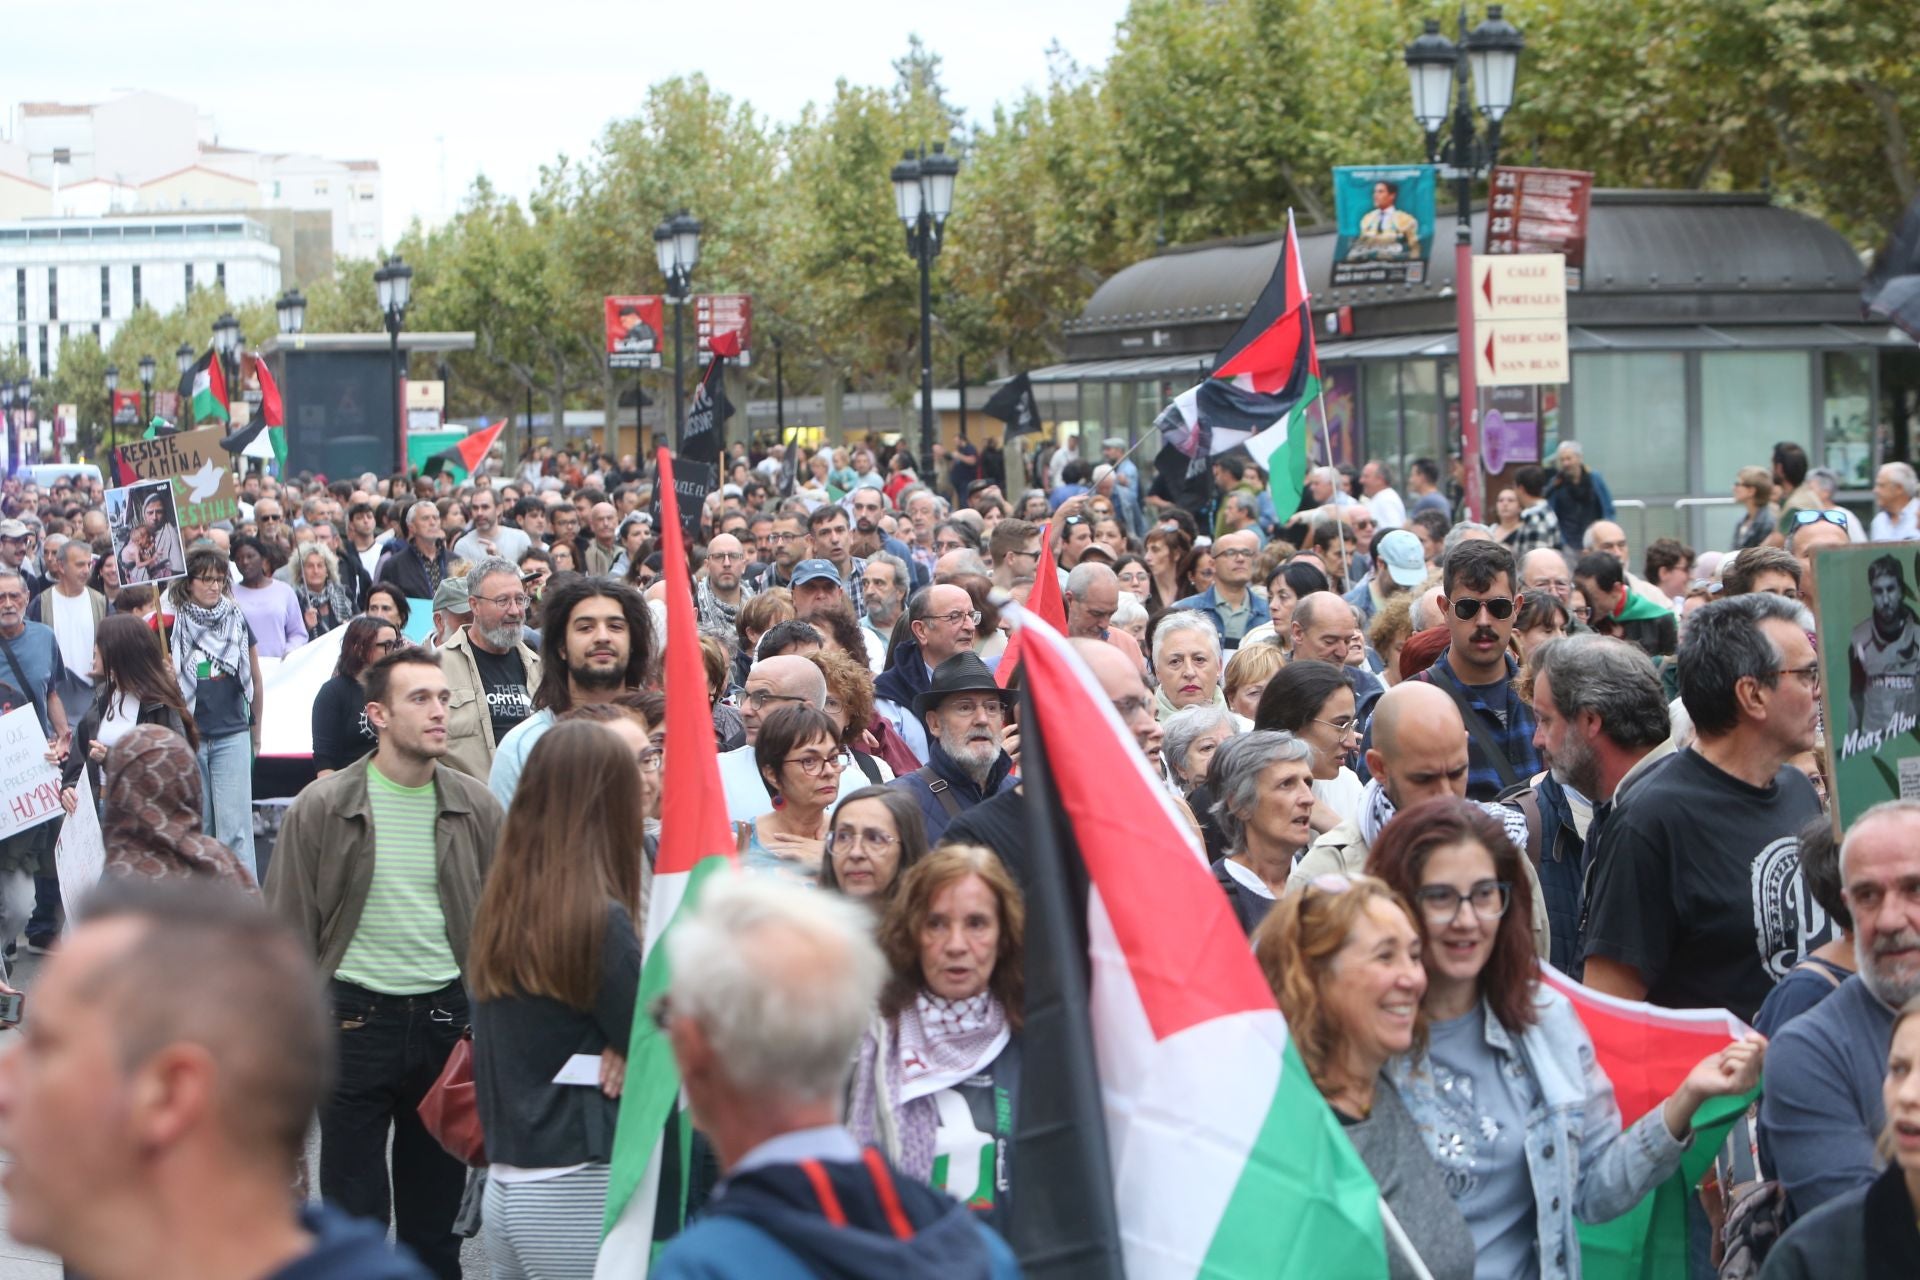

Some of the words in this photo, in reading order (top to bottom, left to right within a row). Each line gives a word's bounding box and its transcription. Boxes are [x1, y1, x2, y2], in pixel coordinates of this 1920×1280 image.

[1506, 267, 1547, 278] CALLE
[1497, 295, 1561, 305] PORTALES
[1500, 333, 1561, 344] MERCADO
[1501, 360, 1525, 370] SAN
[1529, 359, 1560, 369] BLAS
[121, 436, 178, 464] RESISTE
[135, 450, 202, 479] CAMINA
[179, 497, 238, 528] ESTINA
[493, 684, 520, 695] THE
[1884, 676, 1913, 690] PRESS
[486, 692, 523, 706] ORTH
[492, 704, 525, 717] FACE
[1884, 711, 1916, 742] Abu
